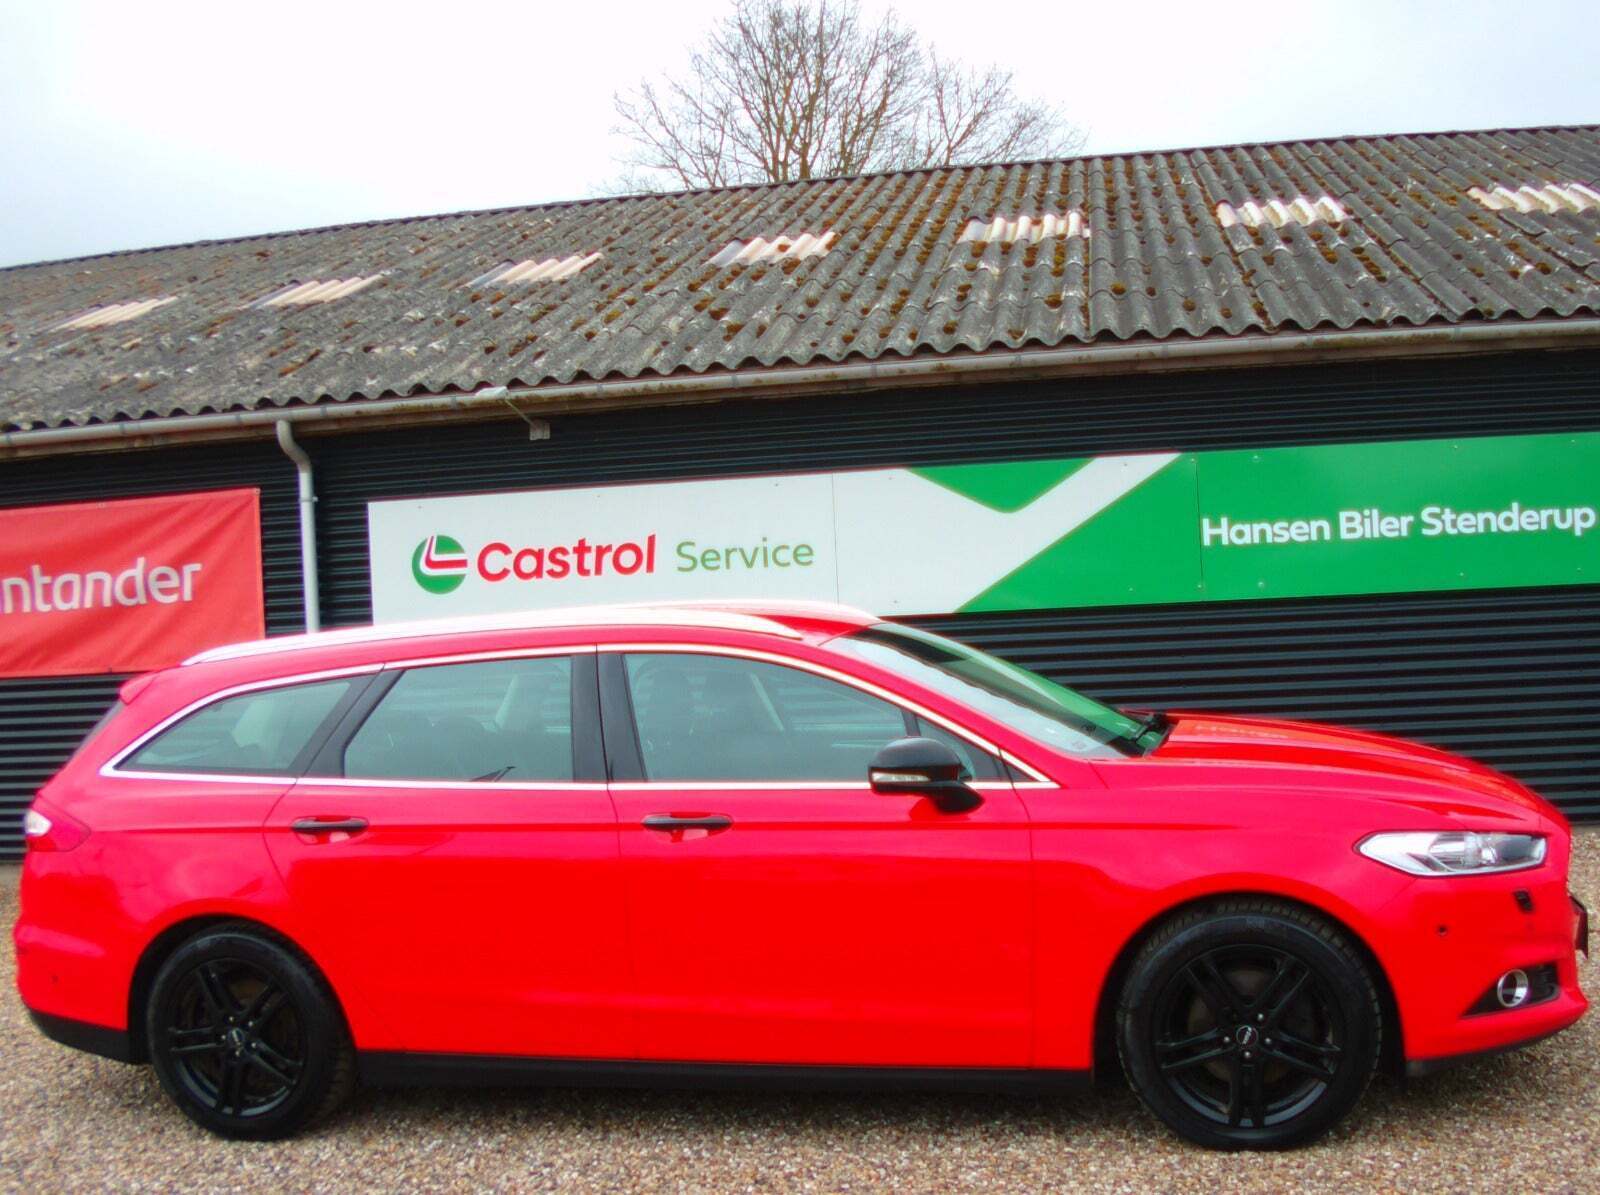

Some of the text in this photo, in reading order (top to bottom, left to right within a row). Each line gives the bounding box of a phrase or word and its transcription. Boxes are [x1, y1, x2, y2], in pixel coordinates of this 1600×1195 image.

[1202, 502, 1597, 546] Hansen Biler Stenderup
[477, 533, 814, 582] Castrol Service
[2, 557, 202, 614] ntander
